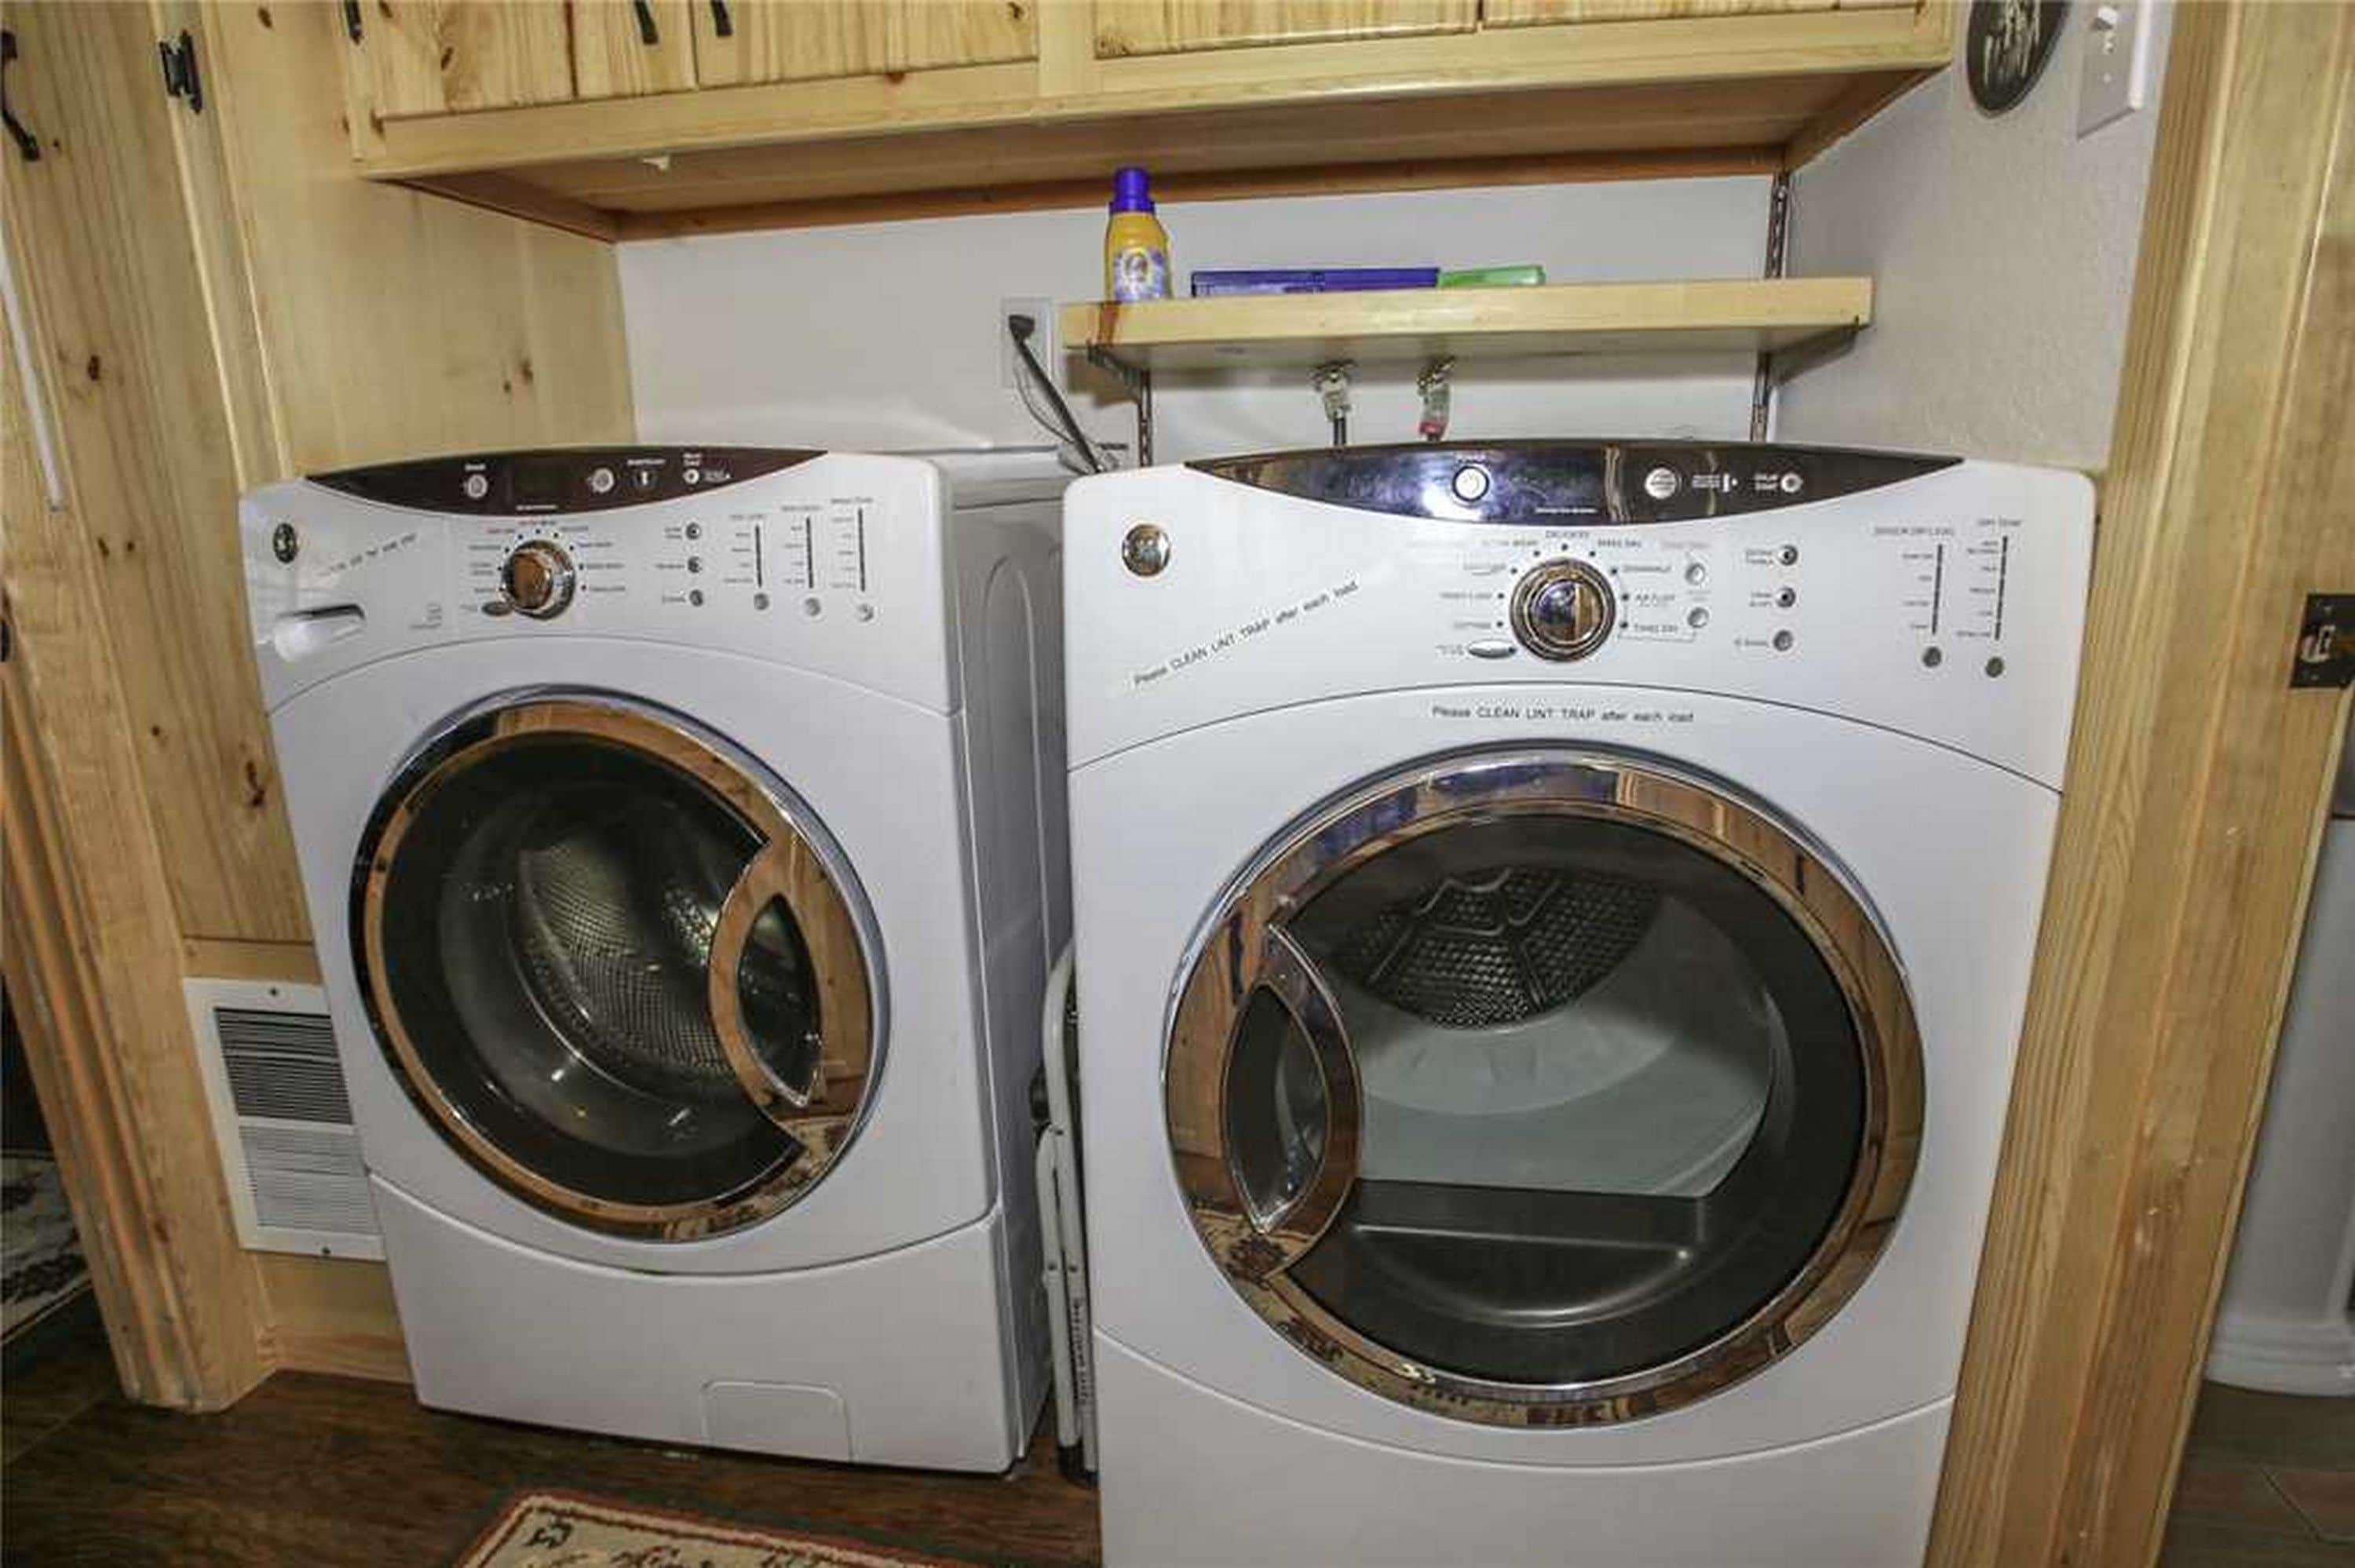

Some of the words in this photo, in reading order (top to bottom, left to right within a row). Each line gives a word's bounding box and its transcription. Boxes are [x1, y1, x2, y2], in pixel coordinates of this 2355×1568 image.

[1170, 647, 1208, 670] CLEAN
[1211, 633, 1236, 653] LINT
[1240, 618, 1271, 639] TRAP
[1302, 593, 1331, 611] each
[1432, 706, 1471, 717] Please
[1475, 707, 1520, 719] CLEAN
[1525, 708, 1554, 720] LINT
[1561, 708, 1596, 720] TRAP
[1601, 710, 1627, 721] after
[1633, 712, 1662, 722] each
[1667, 712, 1694, 722] load
